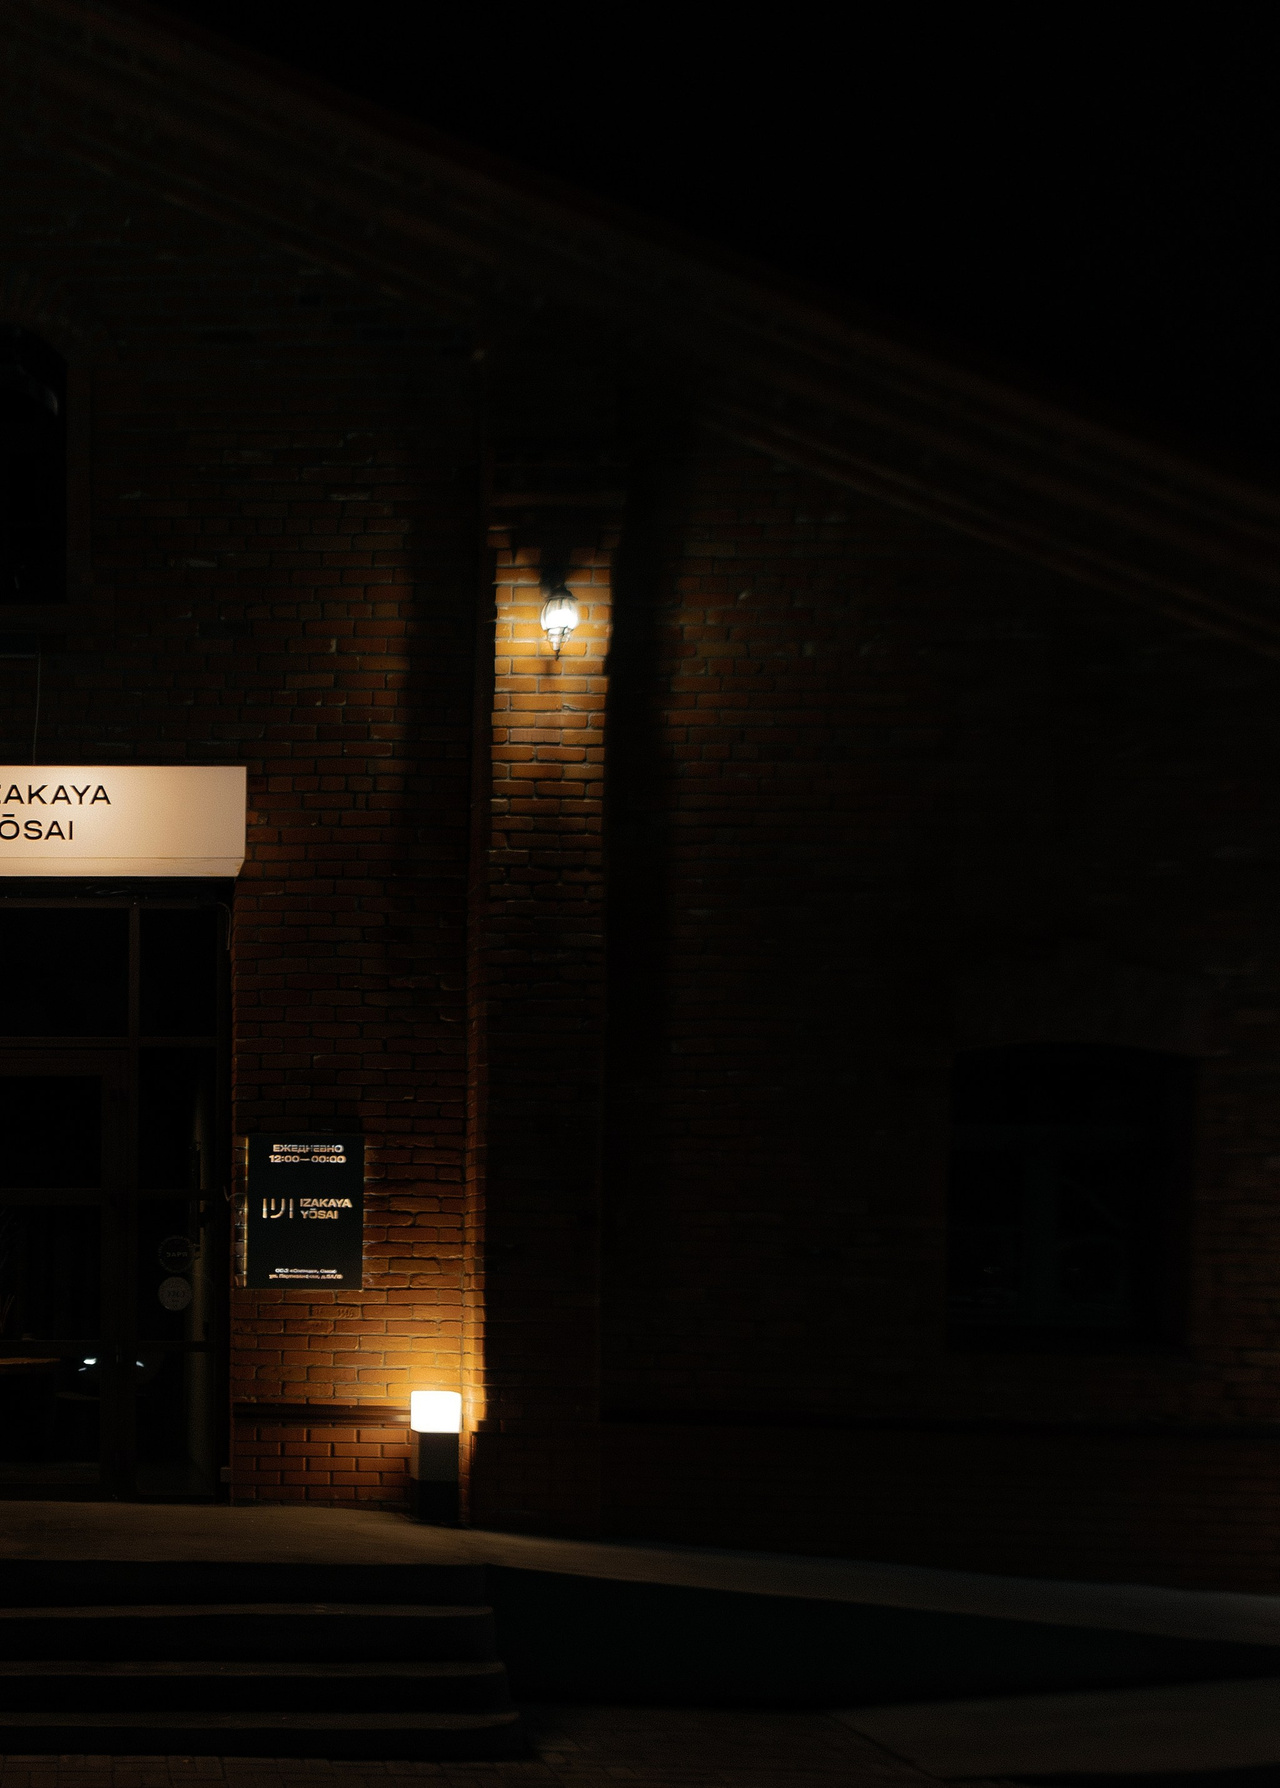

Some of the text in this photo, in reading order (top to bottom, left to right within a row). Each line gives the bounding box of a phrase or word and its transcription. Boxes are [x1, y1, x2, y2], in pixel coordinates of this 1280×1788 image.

[272, 1144, 344, 1153] ЕЖЕДНЕВНО
[299, 1198, 352, 1208] IZAKAYA
[300, 1208, 339, 1220] YŌSAI
